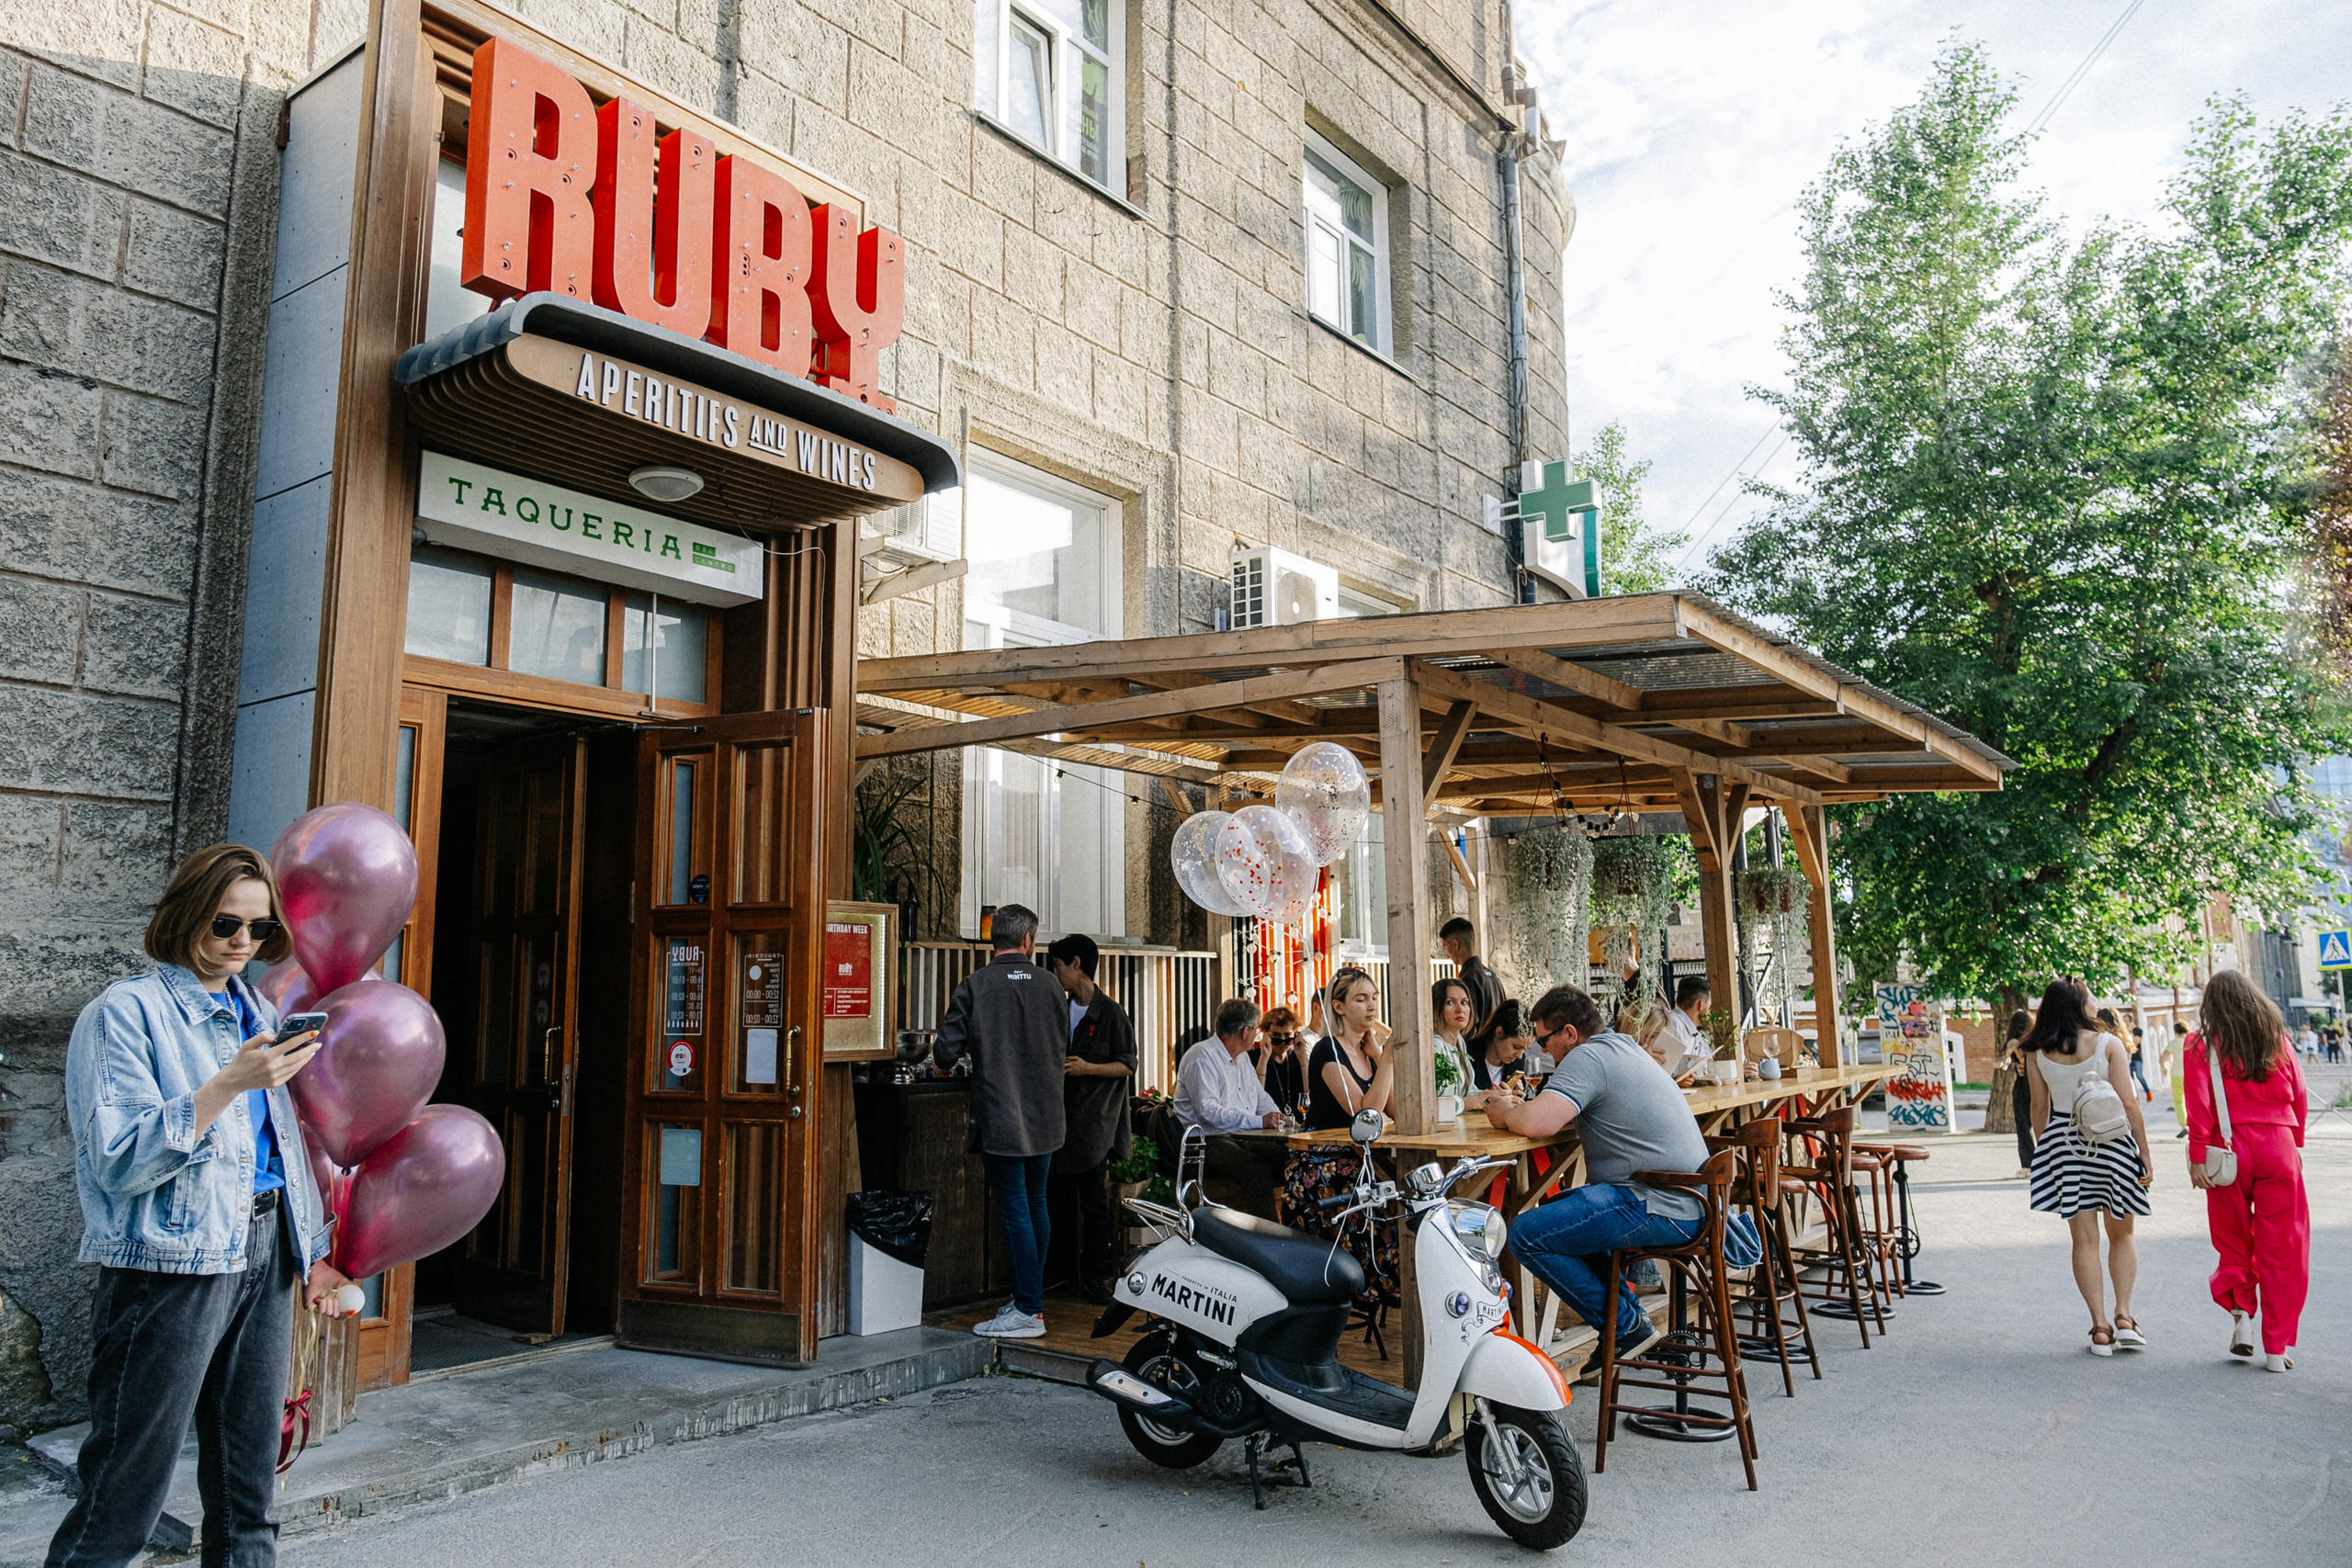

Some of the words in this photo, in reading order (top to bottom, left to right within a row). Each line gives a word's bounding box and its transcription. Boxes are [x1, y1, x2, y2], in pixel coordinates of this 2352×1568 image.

[461, 36, 905, 416] RUBY
[575, 353, 739, 449] APERITIFS
[749, 414, 787, 452] AND
[797, 429, 876, 491] WINES
[448, 476, 683, 561] TAQUERIA
[695, 545, 713, 555] DEL
[695, 557, 733, 570] CENTRO
[826, 923, 852, 933] IRTHDAY
[852, 925, 868, 934] WEEK
[838, 963, 853, 974] RUBY
[1150, 1272, 1236, 1327] MARTINI
[1211, 1286, 1238, 1303] ITALIA
